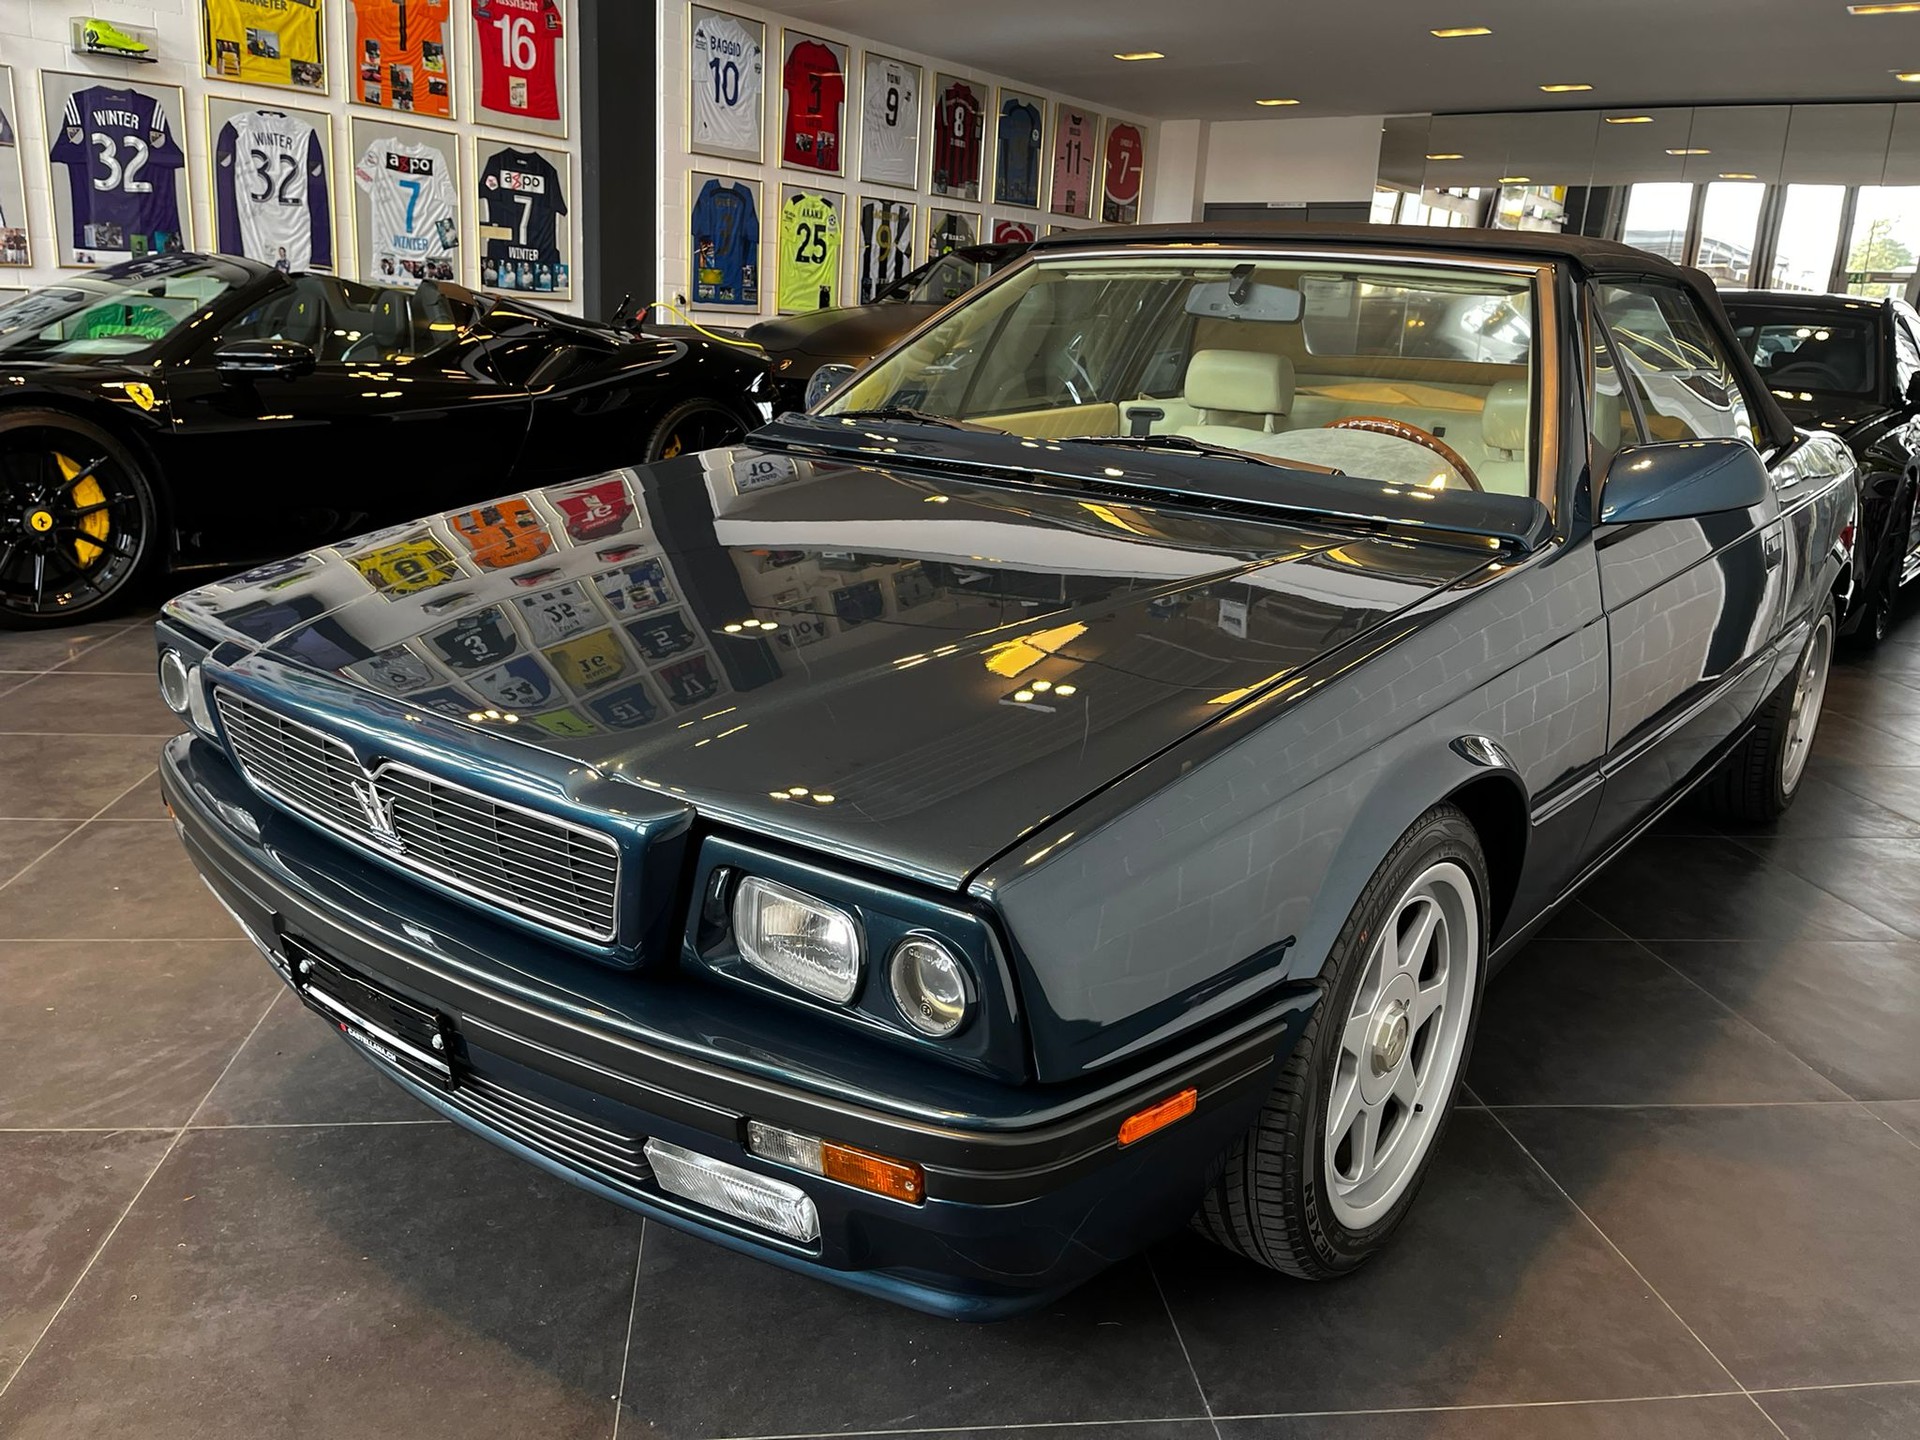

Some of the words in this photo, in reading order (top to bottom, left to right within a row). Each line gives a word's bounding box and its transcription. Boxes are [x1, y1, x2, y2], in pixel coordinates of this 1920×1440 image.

[493, 13, 537, 71] 16
[711, 35, 741, 57] BAGGIO
[709, 57, 739, 106] 10
[93, 110, 139, 130] WINTER
[885, 88, 899, 127] 9
[954, 106, 965, 137] 8
[253, 132, 293, 150] WINTER
[1066, 139, 1082, 175] 11
[92, 132, 153, 192] 32
[251, 149, 303, 206] 32
[1120, 151, 1130, 184] 7
[398, 179, 421, 234] 7
[513, 194, 533, 246] 7
[393, 235, 428, 251] WINTER
[508, 246, 540, 261] WINTER
[795, 222, 827, 265] 25
[876, 224, 892, 262] 9
[1304, 1181, 1337, 1263] NEXEN
